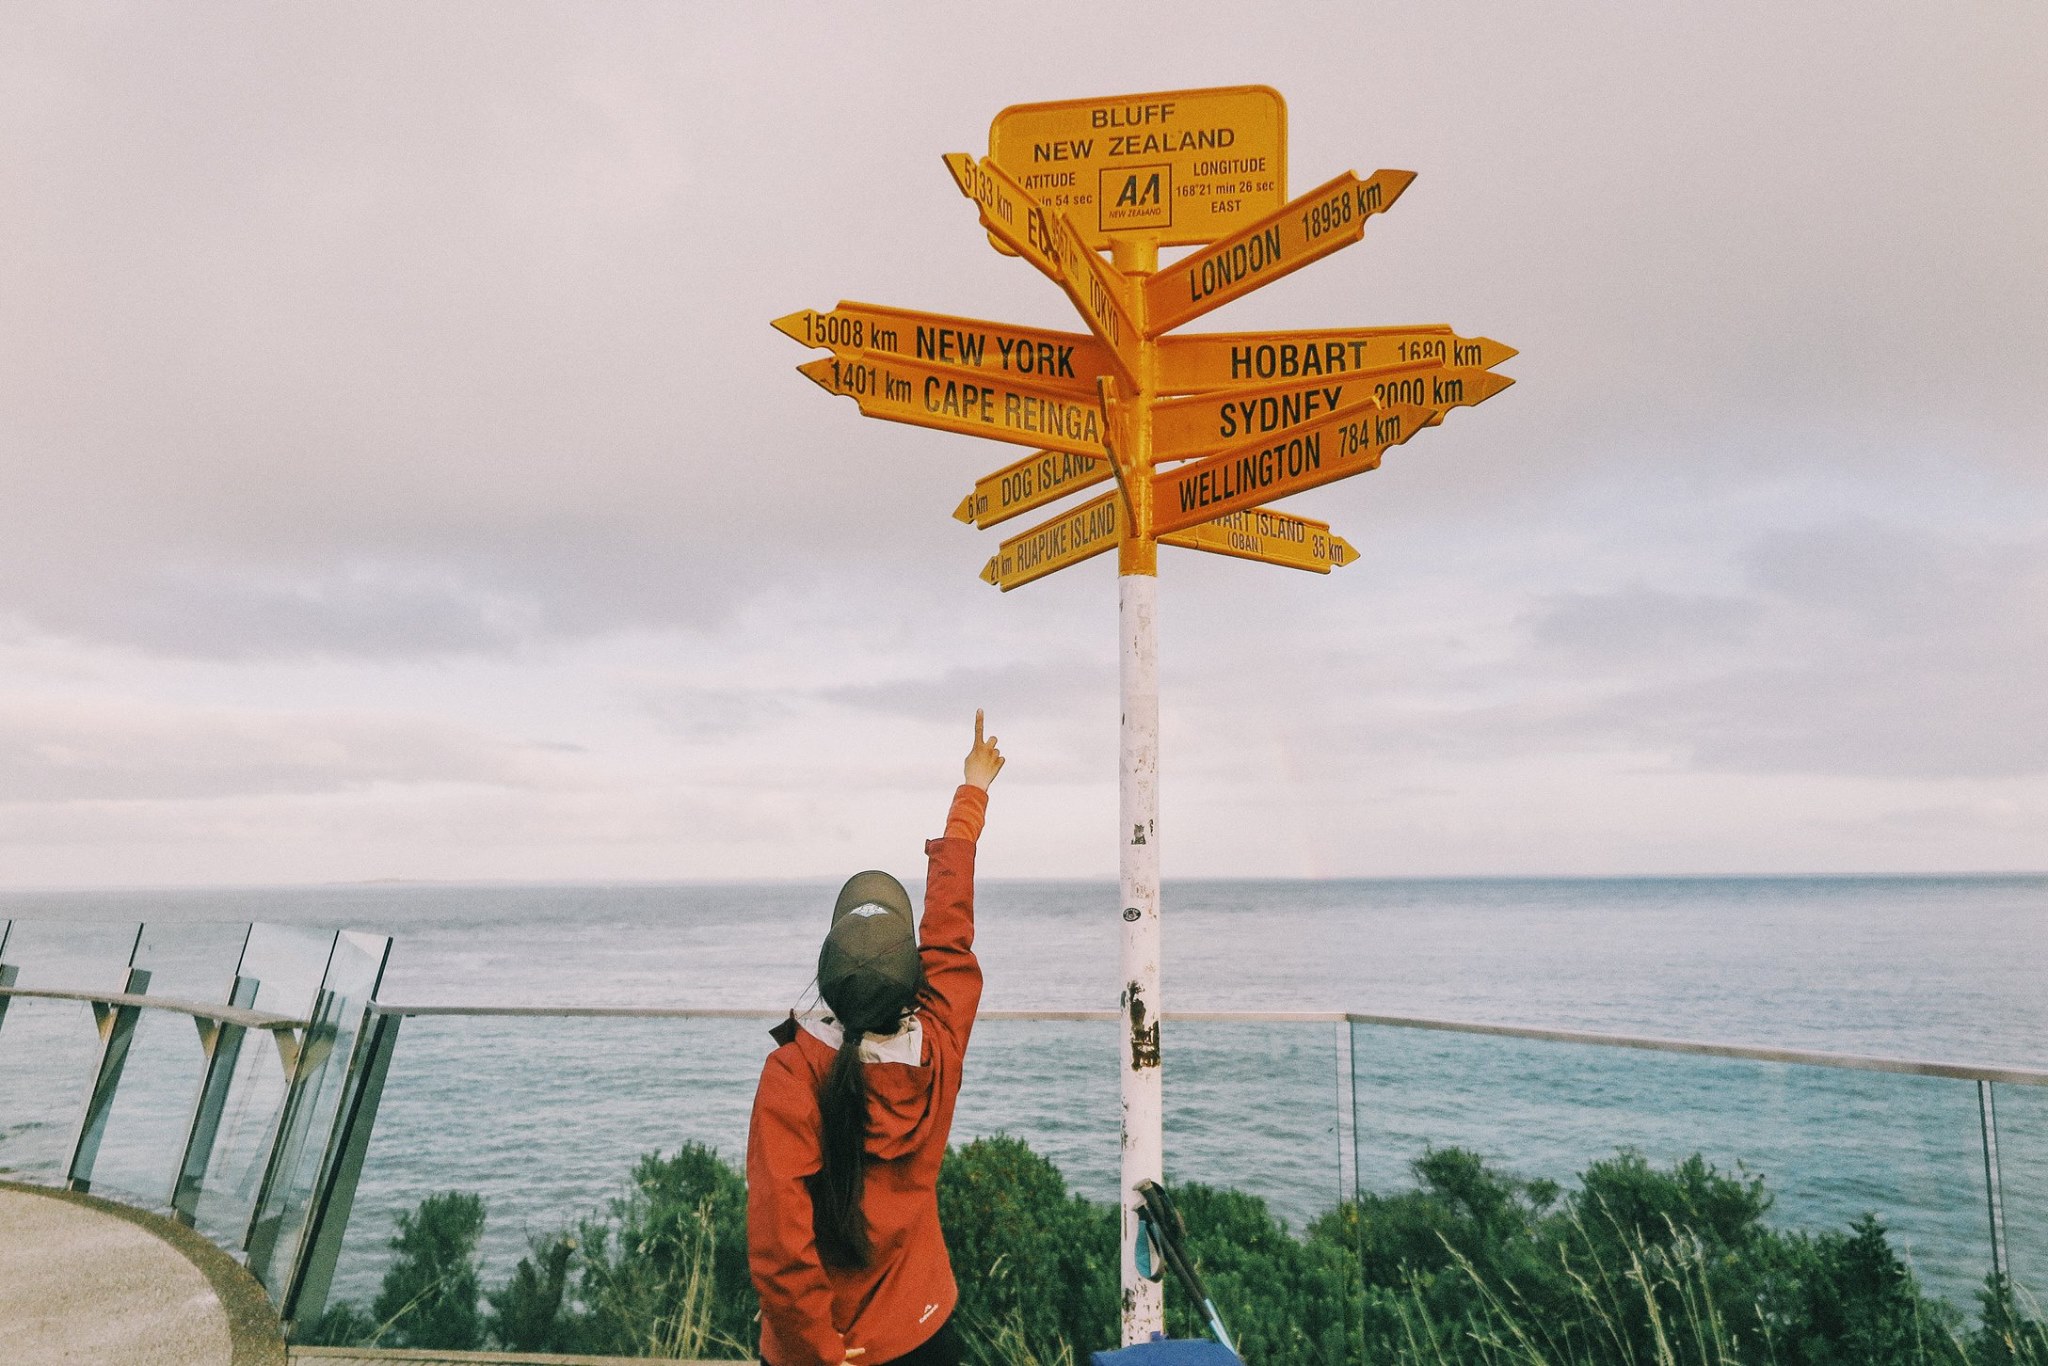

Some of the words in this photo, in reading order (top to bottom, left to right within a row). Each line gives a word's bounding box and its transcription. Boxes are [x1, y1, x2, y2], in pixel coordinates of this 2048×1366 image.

[1092, 103, 1176, 129] BLUFF
[1033, 139, 1093, 163] NEW
[1109, 128, 1235, 157] ZEALAND
[1193, 157, 1266, 176] LONGITUDE
[965, 158, 993, 208] 5133
[997, 185, 1013, 225] km
[1056, 194, 1069, 206] 54
[1073, 195, 1093, 205] sec
[1115, 173, 1160, 207] AA
[1211, 199, 1242, 213] EAST
[1216, 182, 1236, 195] min
[1239, 180, 1253, 193] 26
[1256, 180, 1275, 192] sec
[1109, 210, 1126, 219] NEW
[1128, 206, 1162, 218] ZEALAND
[1190, 225, 1281, 302] LONDON
[1301, 198, 1352, 242] 18958
[1356, 182, 1383, 213] km
[1088, 267, 1119, 347] TOKYO
[802, 313, 863, 347] 15008
[871, 323, 898, 353] km
[916, 326, 985, 367] NEW
[996, 336, 1076, 379] YORK
[1231, 341, 1368, 380] HOBART
[1397, 339, 1446, 362] 1680
[1454, 339, 1482, 367] km
[831, 359, 877, 396] 1401
[885, 370, 912, 403] km
[924, 376, 994, 423] CAPE
[1005, 392, 1099, 443] REINGA
[1220, 386, 1343, 438] SYDNEY
[1375, 377, 1424, 411] 2000
[1433, 377, 1463, 405] km
[968, 496, 974, 518] 6
[976, 493, 988, 516] km
[1001, 467, 1033, 507] DOG
[1037, 453, 1096, 492] ISLAND
[1179, 432, 1320, 513] WELLINGTON
[1339, 424, 1368, 458] 784
[1376, 413, 1400, 446] km
[1002, 555, 1012, 576] km
[1016, 525, 1067, 573] RUAPUKE
[1071, 502, 1116, 550] ISLAND
[1227, 530, 1264, 556] (OBAN)
[1256, 513, 1305, 543] ISLAND
[1312, 534, 1326, 560] 35
[1328, 537, 1344, 563] km
